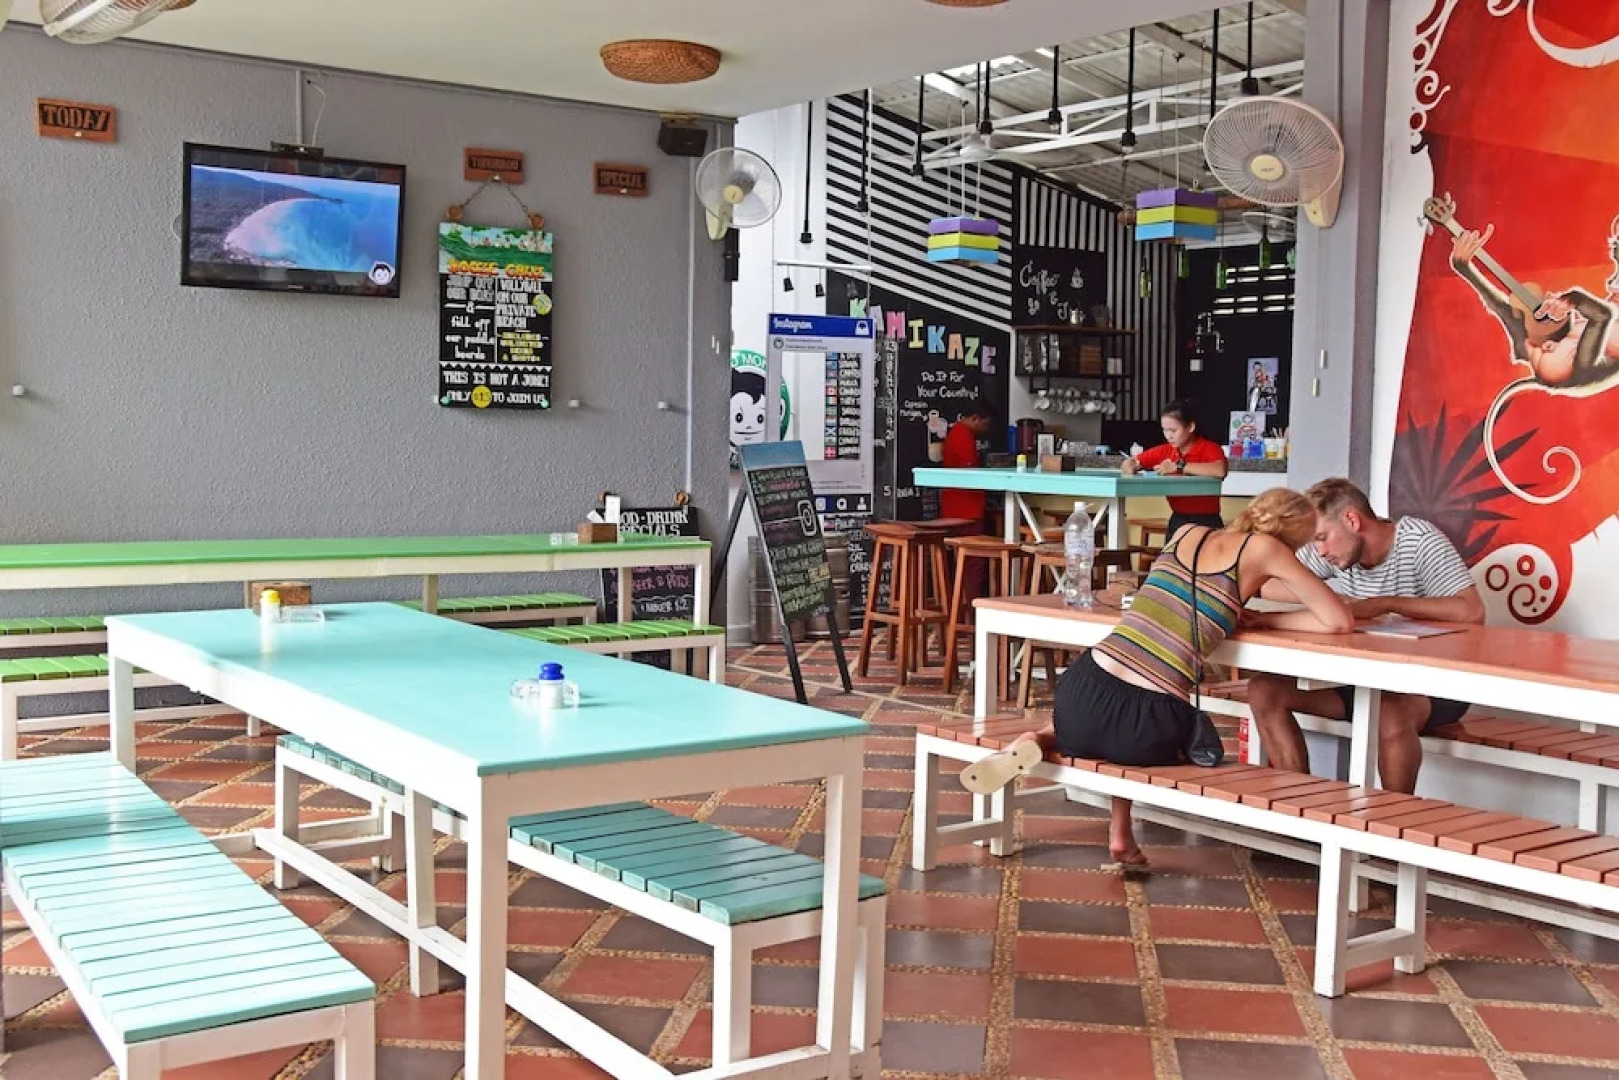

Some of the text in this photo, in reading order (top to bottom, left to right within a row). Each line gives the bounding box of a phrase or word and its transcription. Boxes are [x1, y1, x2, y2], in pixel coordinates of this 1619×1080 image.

[42, 105, 108, 131] TODAY
[600, 170, 643, 188] SPECIAL
[1019, 259, 1060, 294] Coffee
[465, 300, 475, 313] &
[496, 303, 537, 318] PRIVATE
[496, 315, 527, 328] BEACH
[773, 317, 813, 333] Instagram
[850, 298, 997, 375] KAMIKAZE
[443, 371, 469, 385] THIS
[472, 372, 487, 385] IS
[490, 372, 509, 386] NOT
[511, 373, 521, 386] A
[921, 370, 965, 383] Do It For
[491, 392, 504, 403] TO
[507, 393, 531, 404] JOIN
[917, 385, 979, 400] Your Country!
[646, 510, 689, 524] DRINK
